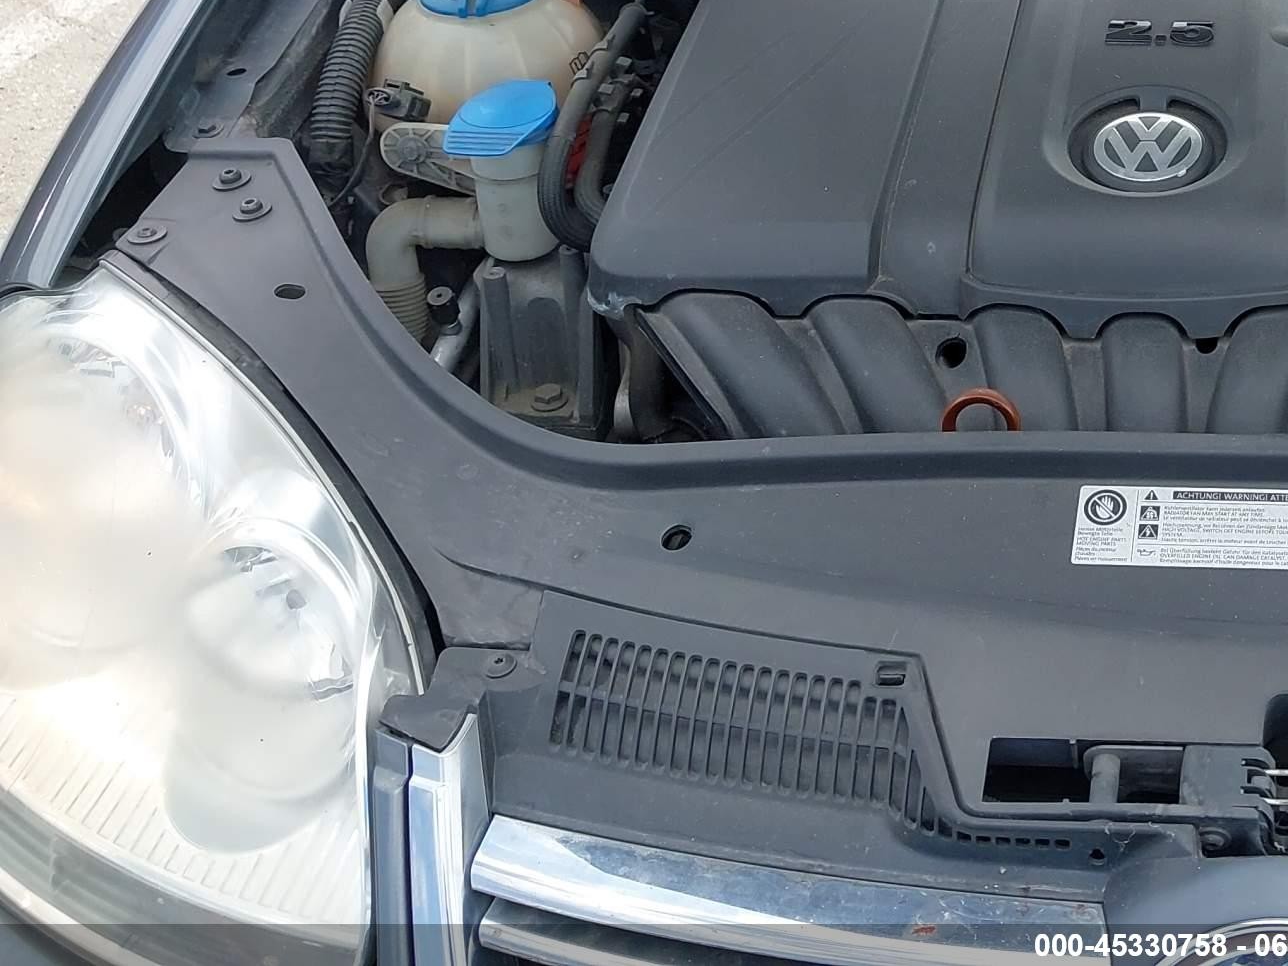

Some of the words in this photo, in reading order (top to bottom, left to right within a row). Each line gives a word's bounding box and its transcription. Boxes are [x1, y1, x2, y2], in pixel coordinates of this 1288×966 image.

[1105, 20, 1215, 46] 2.5
[1096, 114, 1201, 179] VW
[1176, 491, 1221, 500] ACHTUNG!
[1223, 493, 1268, 501] WARNING!
